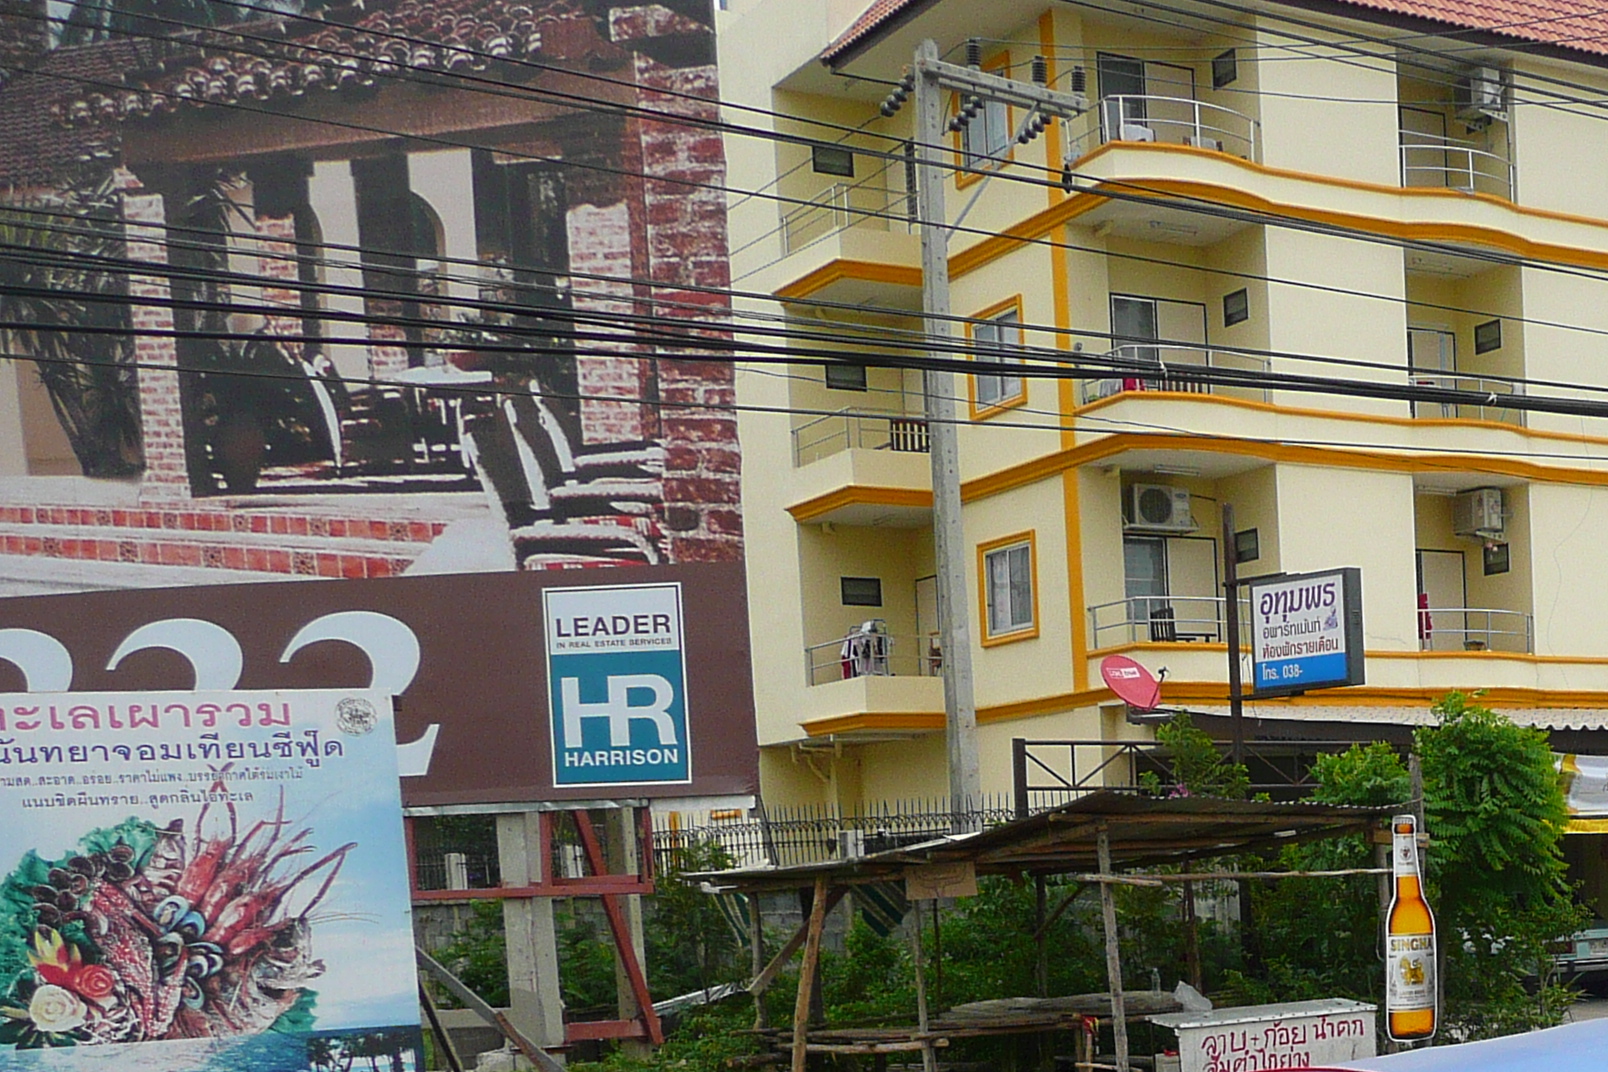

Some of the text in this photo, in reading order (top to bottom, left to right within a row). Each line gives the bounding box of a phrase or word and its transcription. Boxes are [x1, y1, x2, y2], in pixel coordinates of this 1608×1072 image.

[1260, 583, 1335, 623] อุทุมพร
[556, 614, 671, 637] LEADER
[556, 641, 565, 649] IN
[595, 639, 625, 647] ESTATE
[629, 638, 672, 646] SERVICES
[1263, 635, 1338, 660] ห้องพักรายเดือน
[1262, 663, 1280, 680] โทร.
[0, 703, 290, 731] ะเลเผารวม
[561, 673, 678, 748] HR
[565, 749, 678, 767] HARRISON
[1390, 937, 1433, 951] SINGHA
[1202, 1030, 1247, 1056] ลาบ
[1264, 1021, 1306, 1048] ก้อย
[1313, 1014, 1364, 1040] น้ำตก
